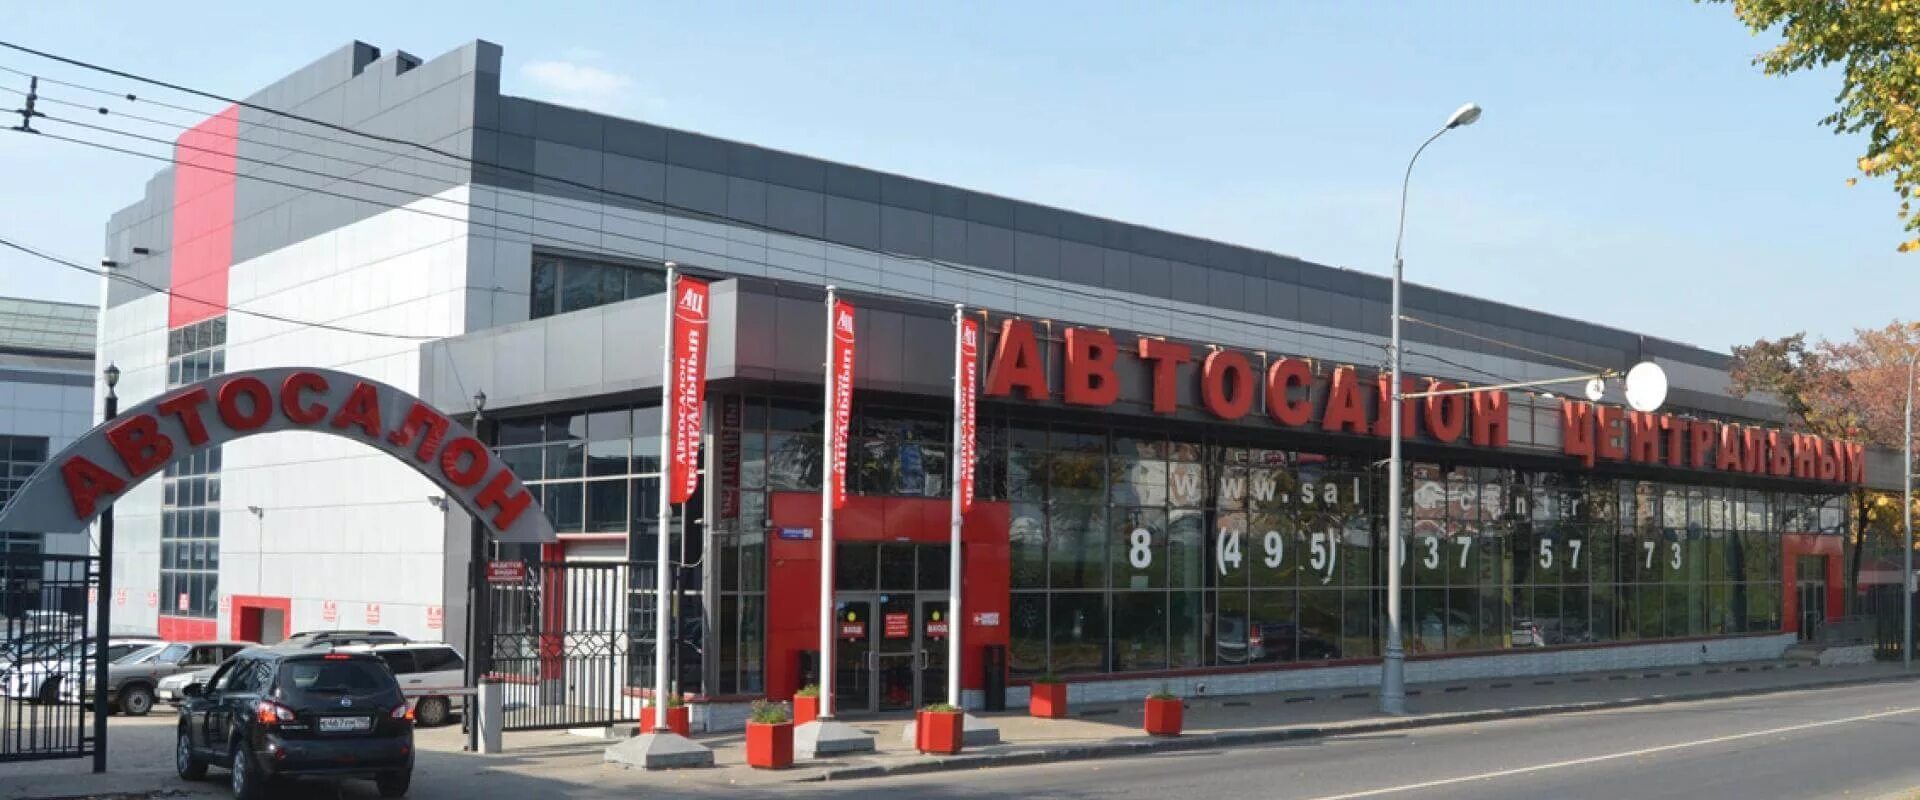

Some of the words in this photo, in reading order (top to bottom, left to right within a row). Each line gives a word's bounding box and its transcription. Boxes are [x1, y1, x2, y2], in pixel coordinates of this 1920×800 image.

[60, 371, 534, 531] АВТОСАЛОН
[985, 318, 1509, 447] АВТОСАЛОН
[1561, 397, 1866, 485] ЦЕНТРАЛЬНЫЙ
[1129, 528, 1152, 569] 8
